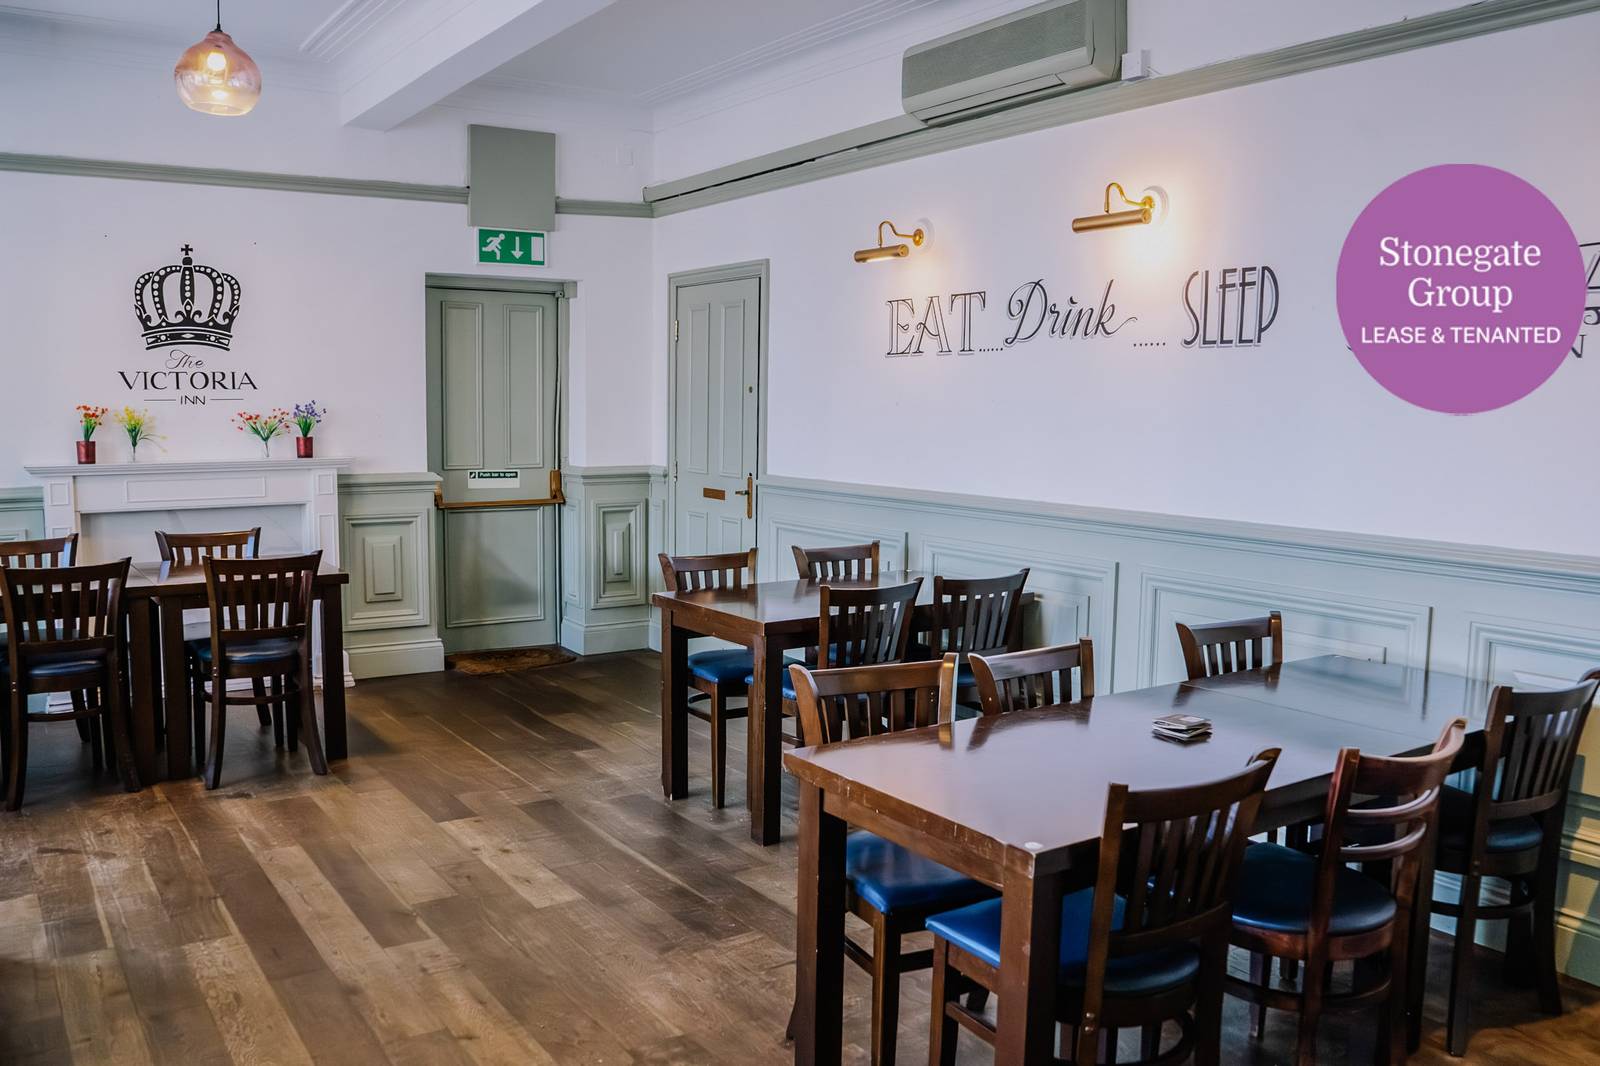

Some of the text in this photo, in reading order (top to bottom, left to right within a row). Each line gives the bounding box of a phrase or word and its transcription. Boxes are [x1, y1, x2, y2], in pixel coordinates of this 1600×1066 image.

[1181, 265, 1279, 346] SLEEP
[165, 349, 205, 369] The
[118, 371, 258, 390] VICTORIA
[180, 395, 206, 405] INN
